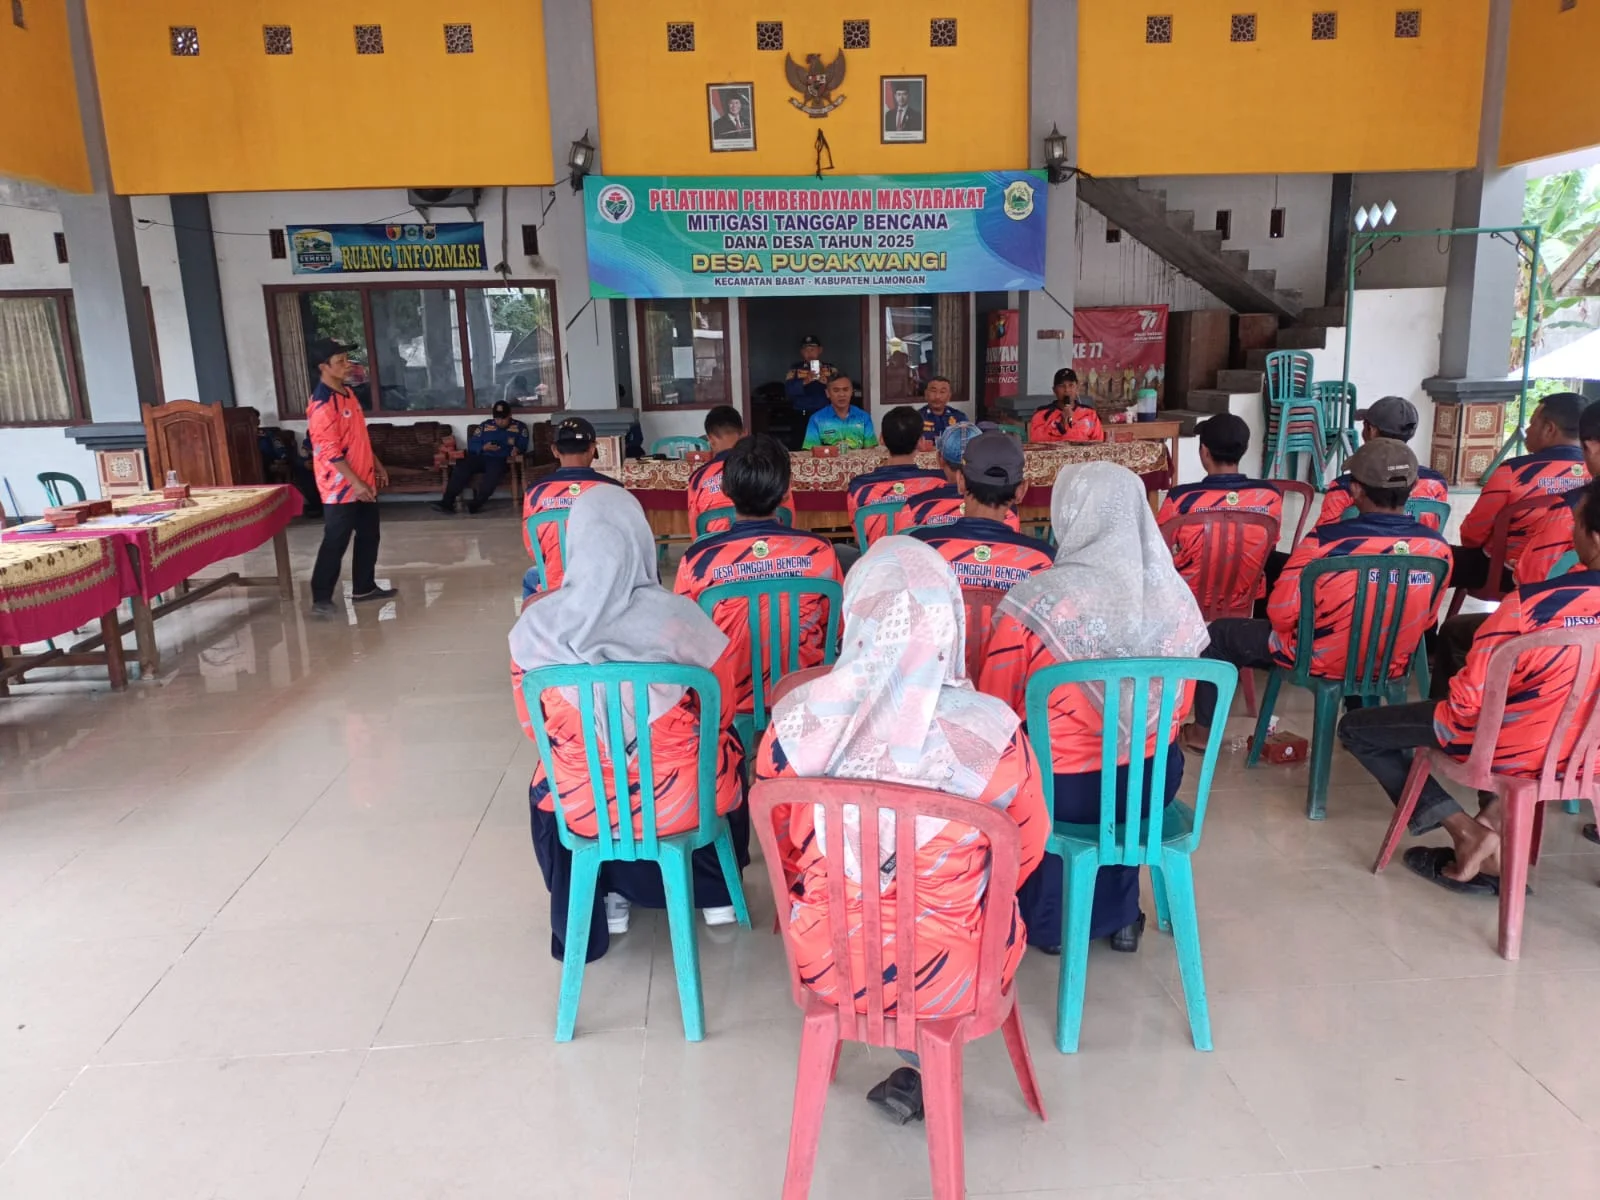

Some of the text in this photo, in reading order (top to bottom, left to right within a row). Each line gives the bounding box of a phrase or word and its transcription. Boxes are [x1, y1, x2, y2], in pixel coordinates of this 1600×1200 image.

[648, 187, 986, 211] PELATIHAN PEMBERDAYAAN MASYARAKAT
[687, 212, 949, 232] MITIGASI TANGGAP BENCANA
[724, 234, 915, 250] DANA DESA TAHUN 2025
[341, 244, 482, 270] RUANG INFORMASI
[691, 251, 947, 273] DESA PUCAKWANGI
[714, 277, 773, 287] KECAMATAN
[774, 276, 806, 286] BABAT
[814, 276, 870, 286] KABUPATEN
[872, 275, 926, 285] LAMONGAN
[713, 565, 733, 580] DESA
[735, 560, 773, 575] TANGGUH
[776, 557, 811, 569] BENCANA
[954, 562, 991, 577] TANGGUH
